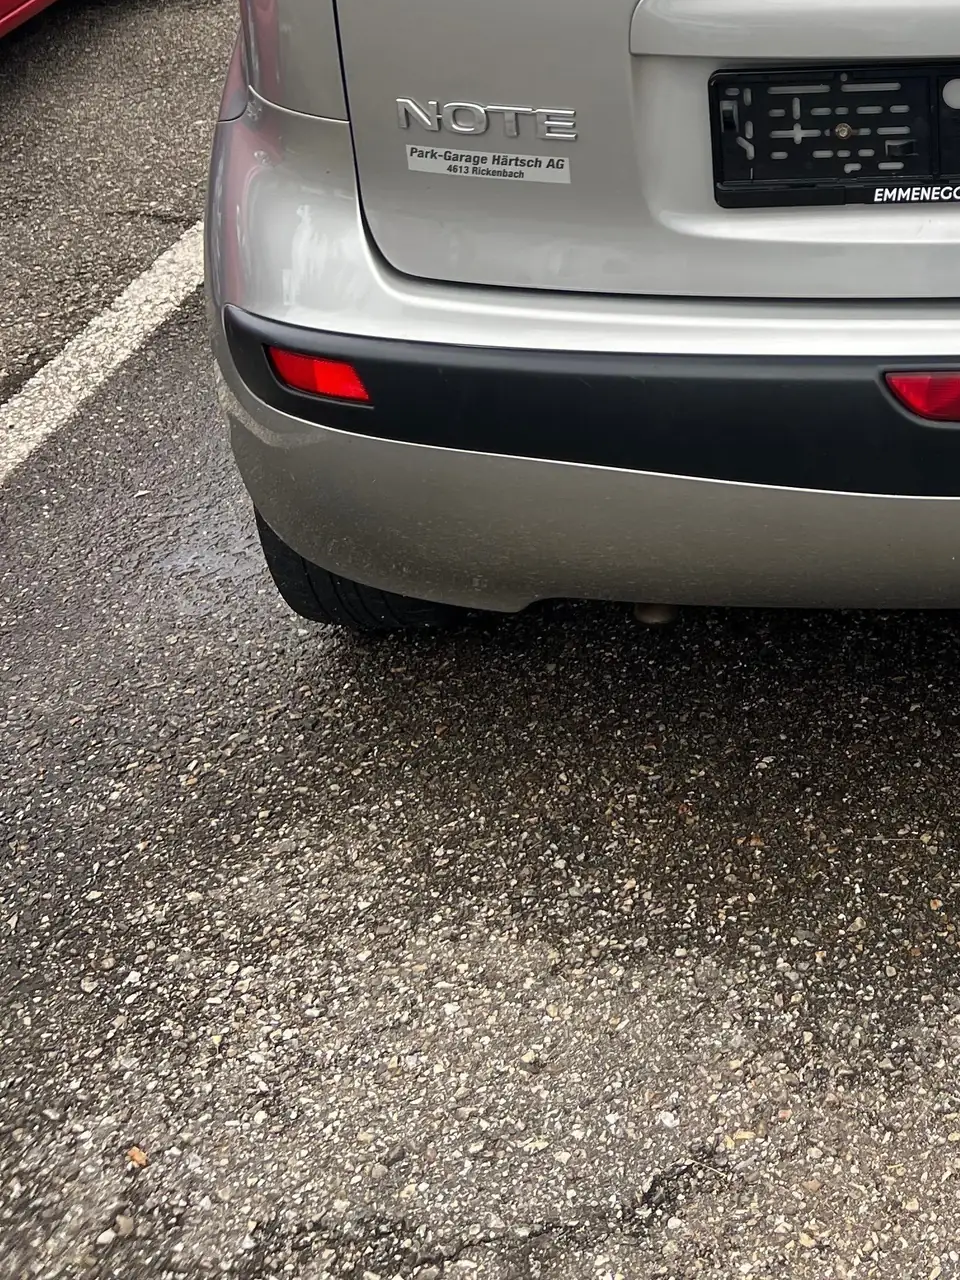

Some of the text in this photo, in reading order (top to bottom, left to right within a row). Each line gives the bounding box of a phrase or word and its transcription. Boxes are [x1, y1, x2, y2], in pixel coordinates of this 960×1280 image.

[396, 97, 578, 141] NOTE
[409, 147, 565, 169] Park-Garage Härtsch AG
[446, 166, 525, 179] 4613 Rickenbach
